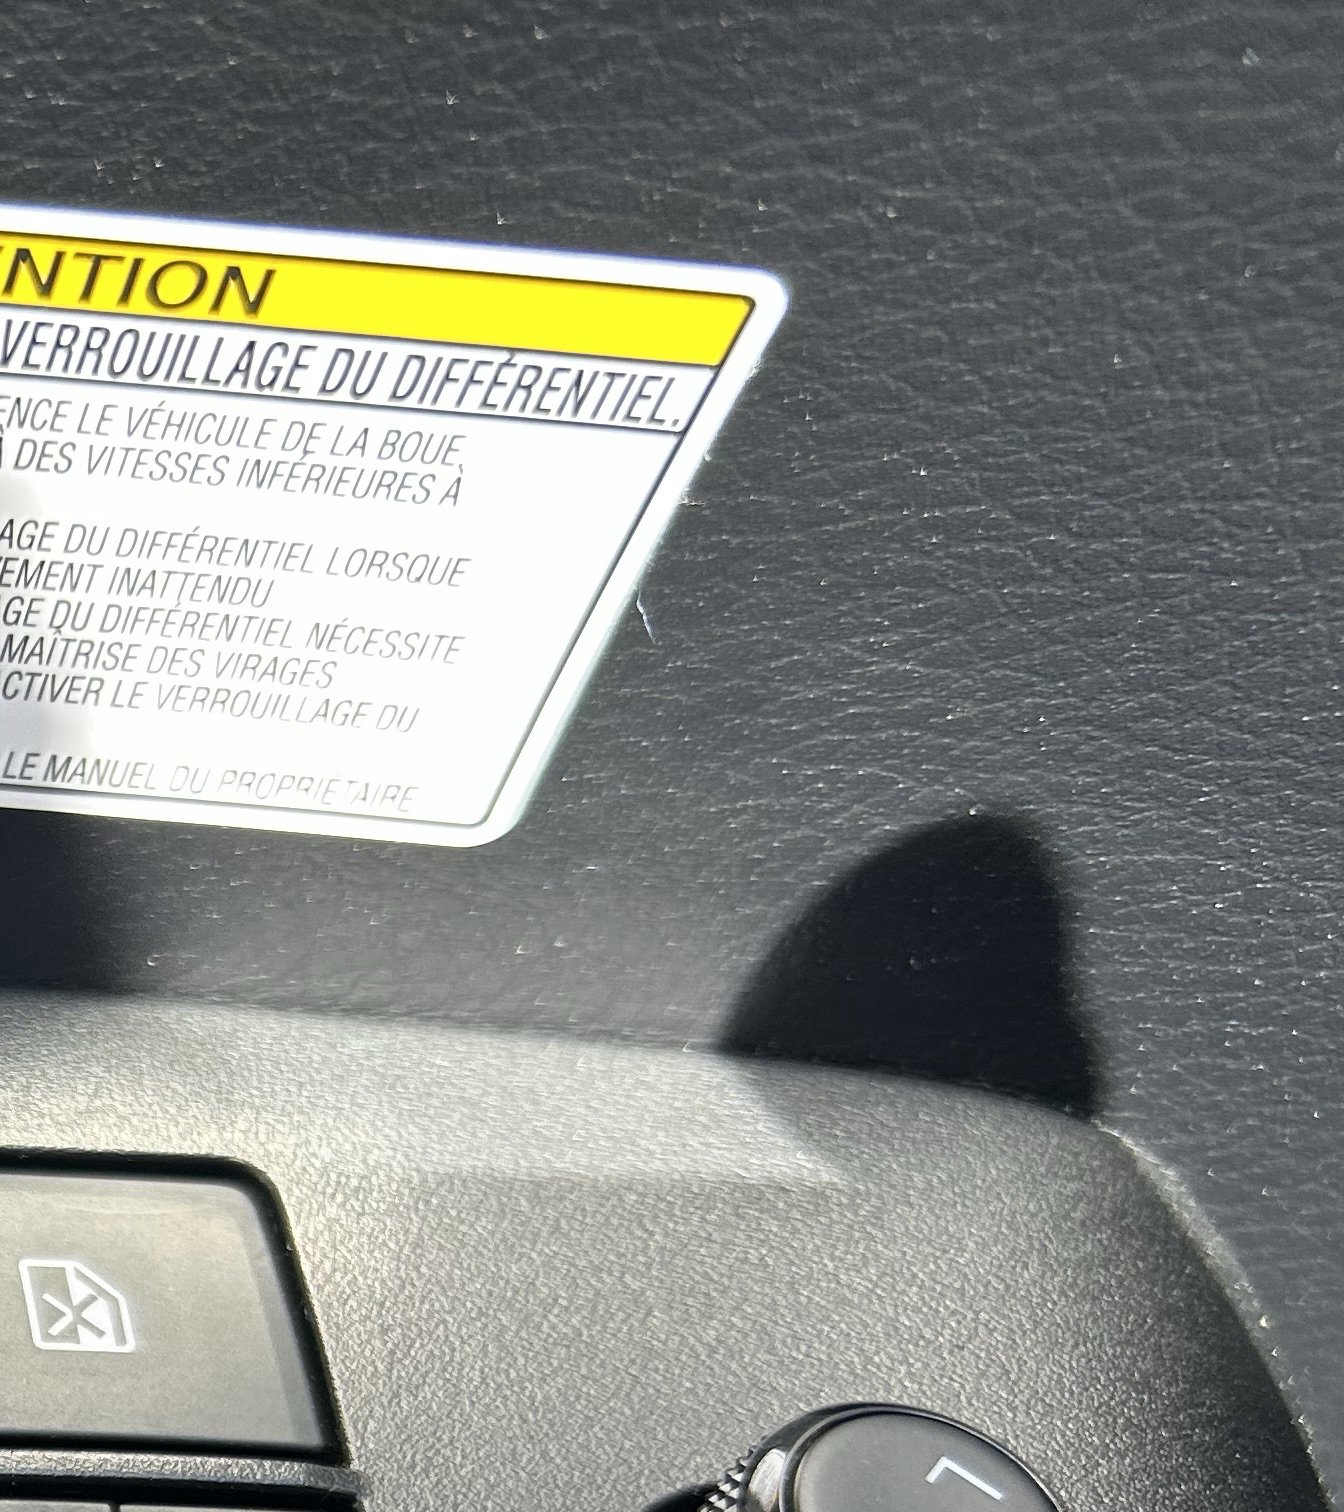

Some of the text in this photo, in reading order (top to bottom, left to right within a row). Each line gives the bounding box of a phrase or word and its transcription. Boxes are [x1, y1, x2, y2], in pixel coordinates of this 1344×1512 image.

[0, 318, 318, 393] VERROUILLAGE
[317, 347, 388, 400] DU
[388, 349, 680, 426] DIFFÉRENTIEL.
[75, 402, 118, 436] LE
[126, 395, 277, 449] VÉHICULE
[280, 419, 327, 455] DE
[328, 424, 369, 457] LA
[1, 750, 41, 781] LE
[924, 1456, 1004, 1501] L
